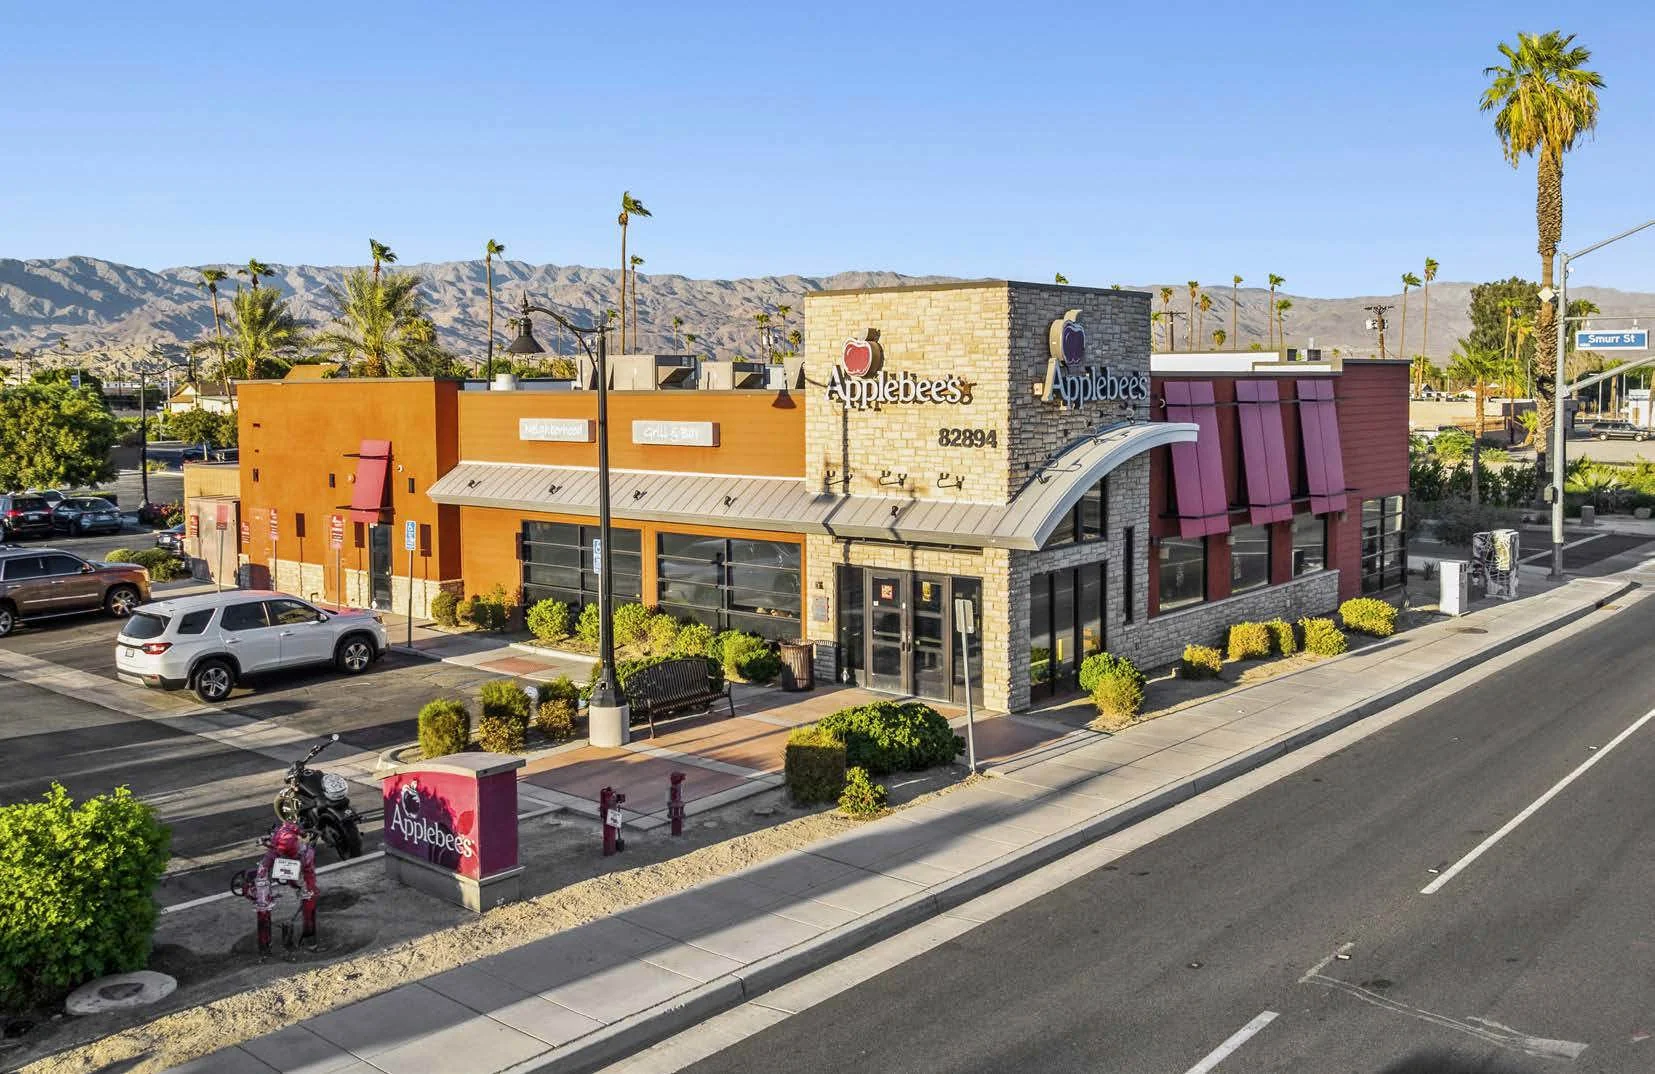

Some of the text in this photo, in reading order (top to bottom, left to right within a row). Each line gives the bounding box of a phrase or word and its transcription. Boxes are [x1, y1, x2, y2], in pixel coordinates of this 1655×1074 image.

[1588, 334, 1636, 344] Smurr St
[824, 364, 963, 409] Applebee's
[1041, 358, 1148, 410] Applebee's
[938, 428, 998, 448] 82894
[391, 803, 473, 858] Applebee's
